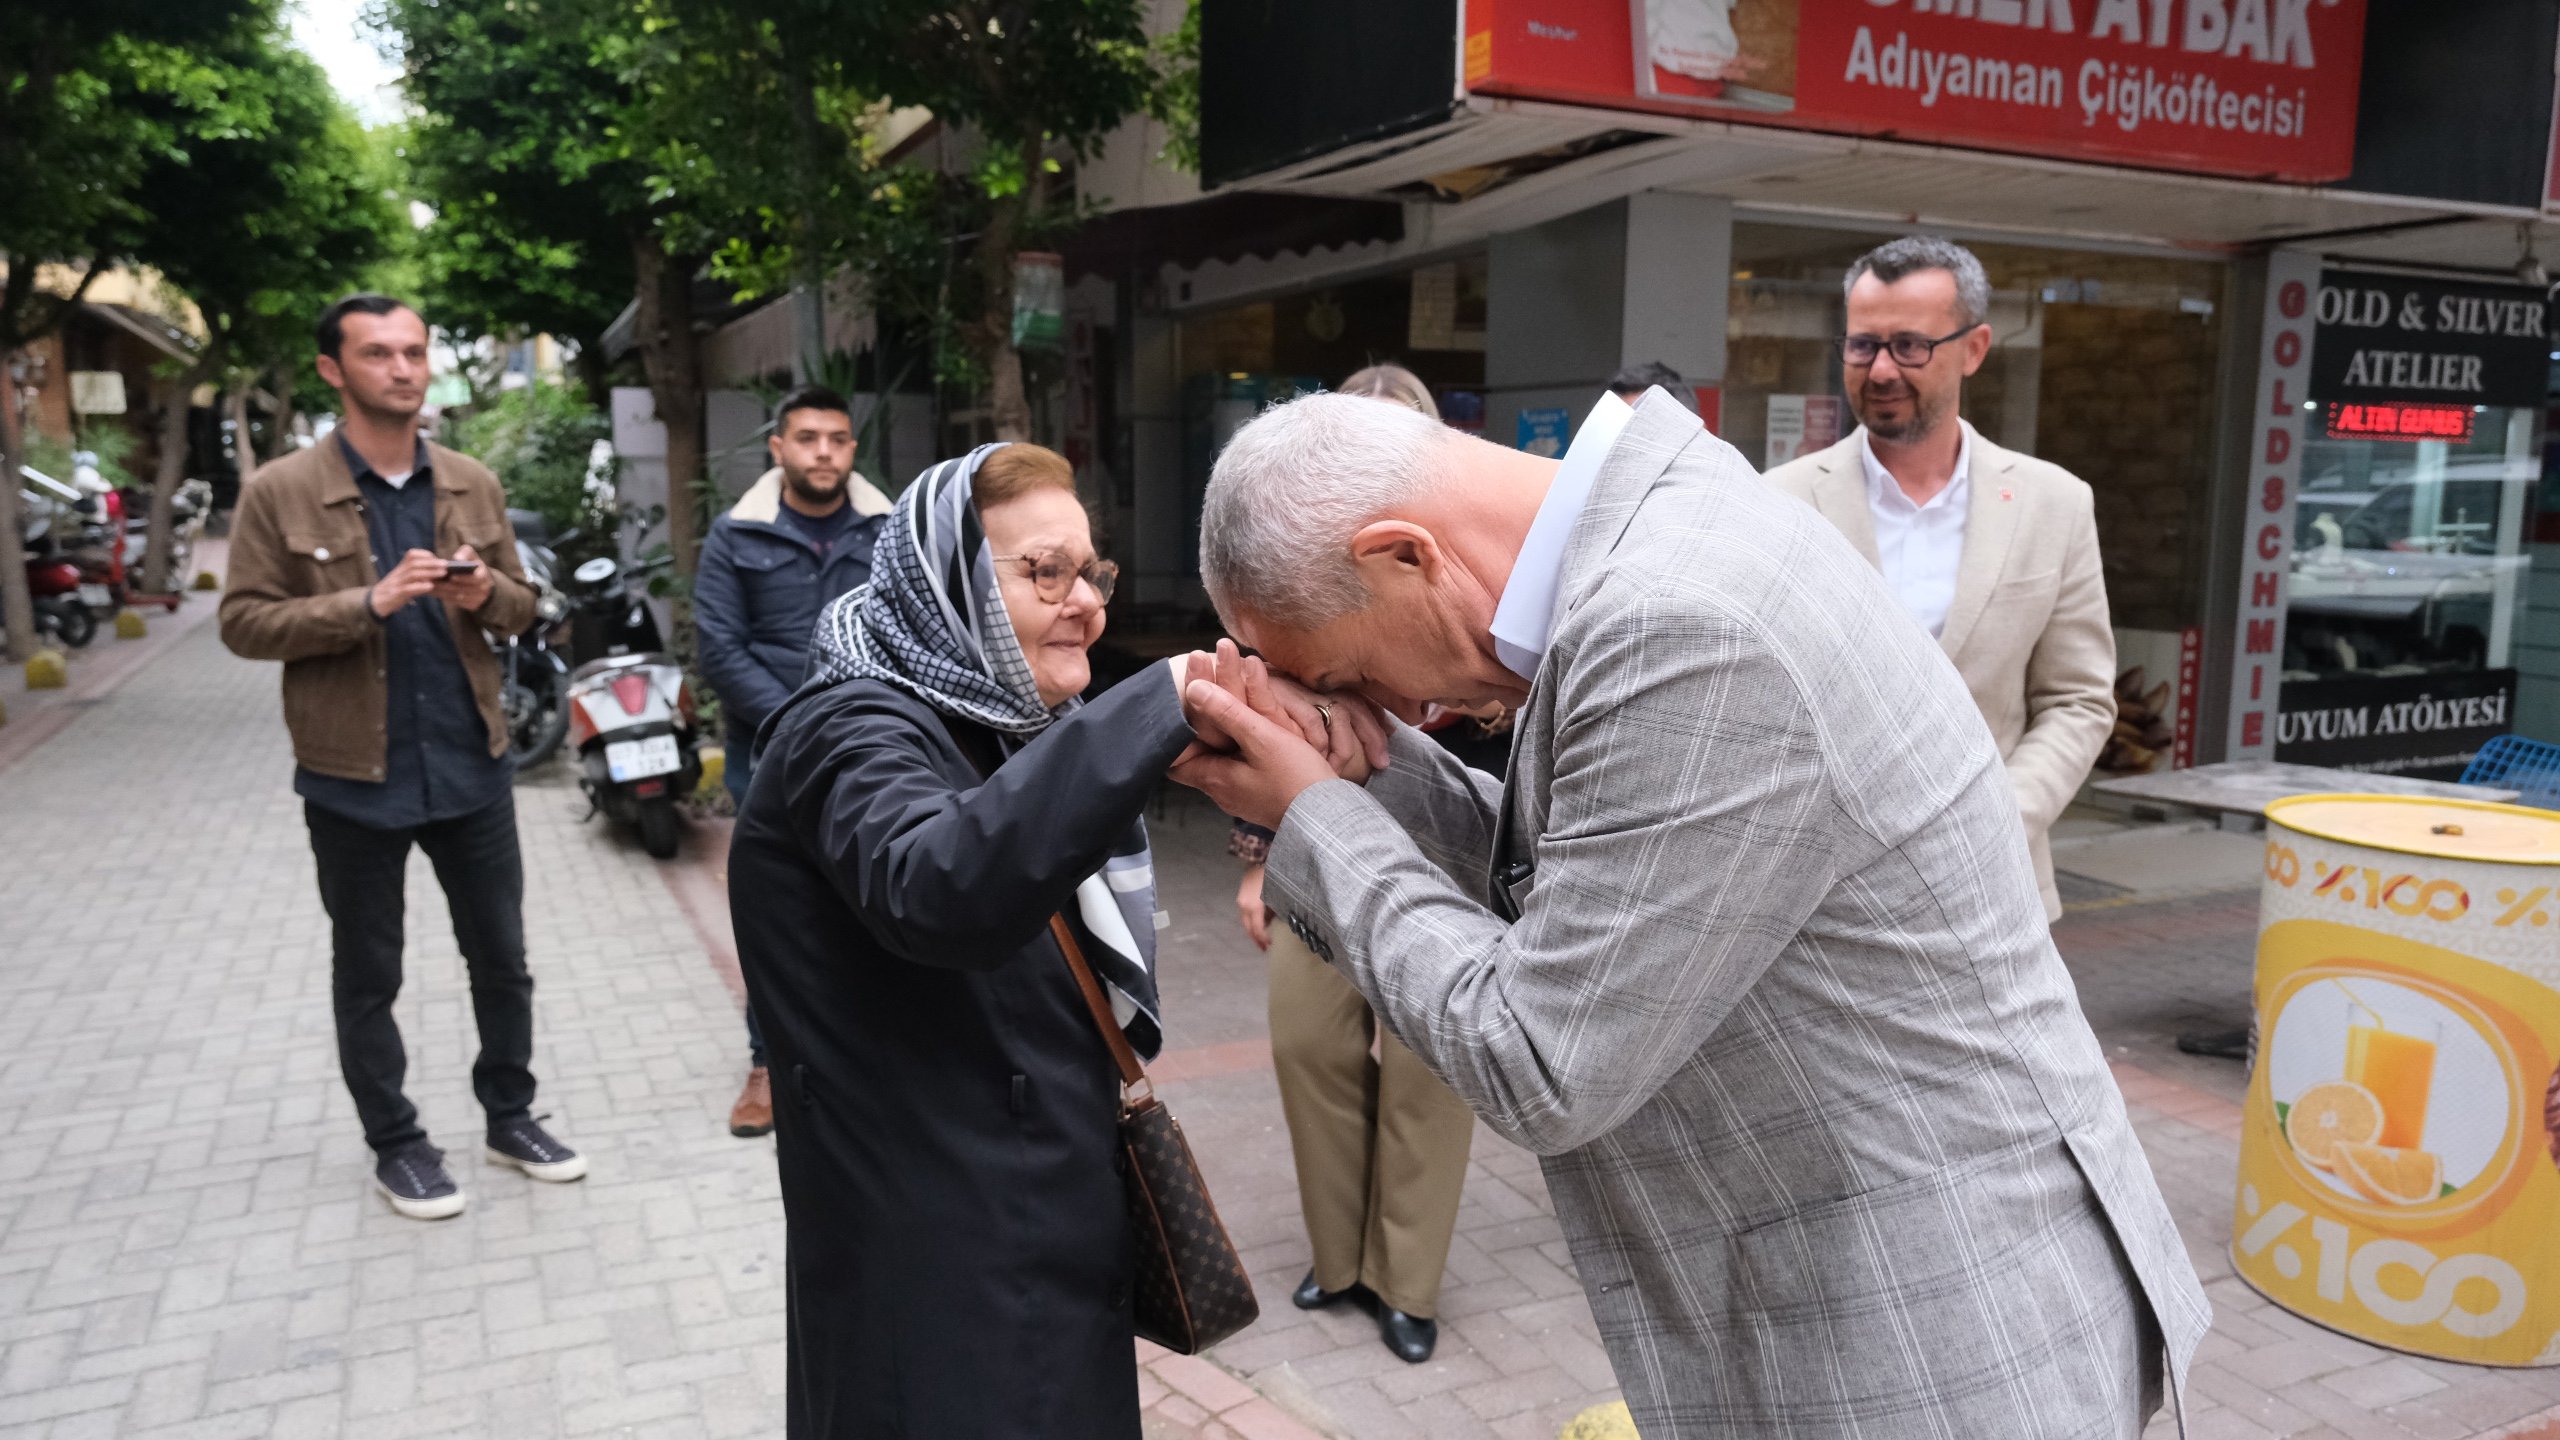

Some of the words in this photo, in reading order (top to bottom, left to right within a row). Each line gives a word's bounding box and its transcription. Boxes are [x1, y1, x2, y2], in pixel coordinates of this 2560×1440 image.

[1844, 26, 2063, 108] Adıyaman
[2078, 58, 2305, 138] Çiğköftecisi
[2316, 286, 2391, 328] OLD
[2399, 291, 2426, 331] &
[2436, 294, 2545, 338] SILVER
[2343, 350, 2483, 392] ATELIER
[2276, 707, 2367, 744] UYUM
[2373, 688, 2507, 735] ATÖLYESİ
[2312, 860, 2470, 921] %100
[2240, 1183, 2527, 1338] %100
